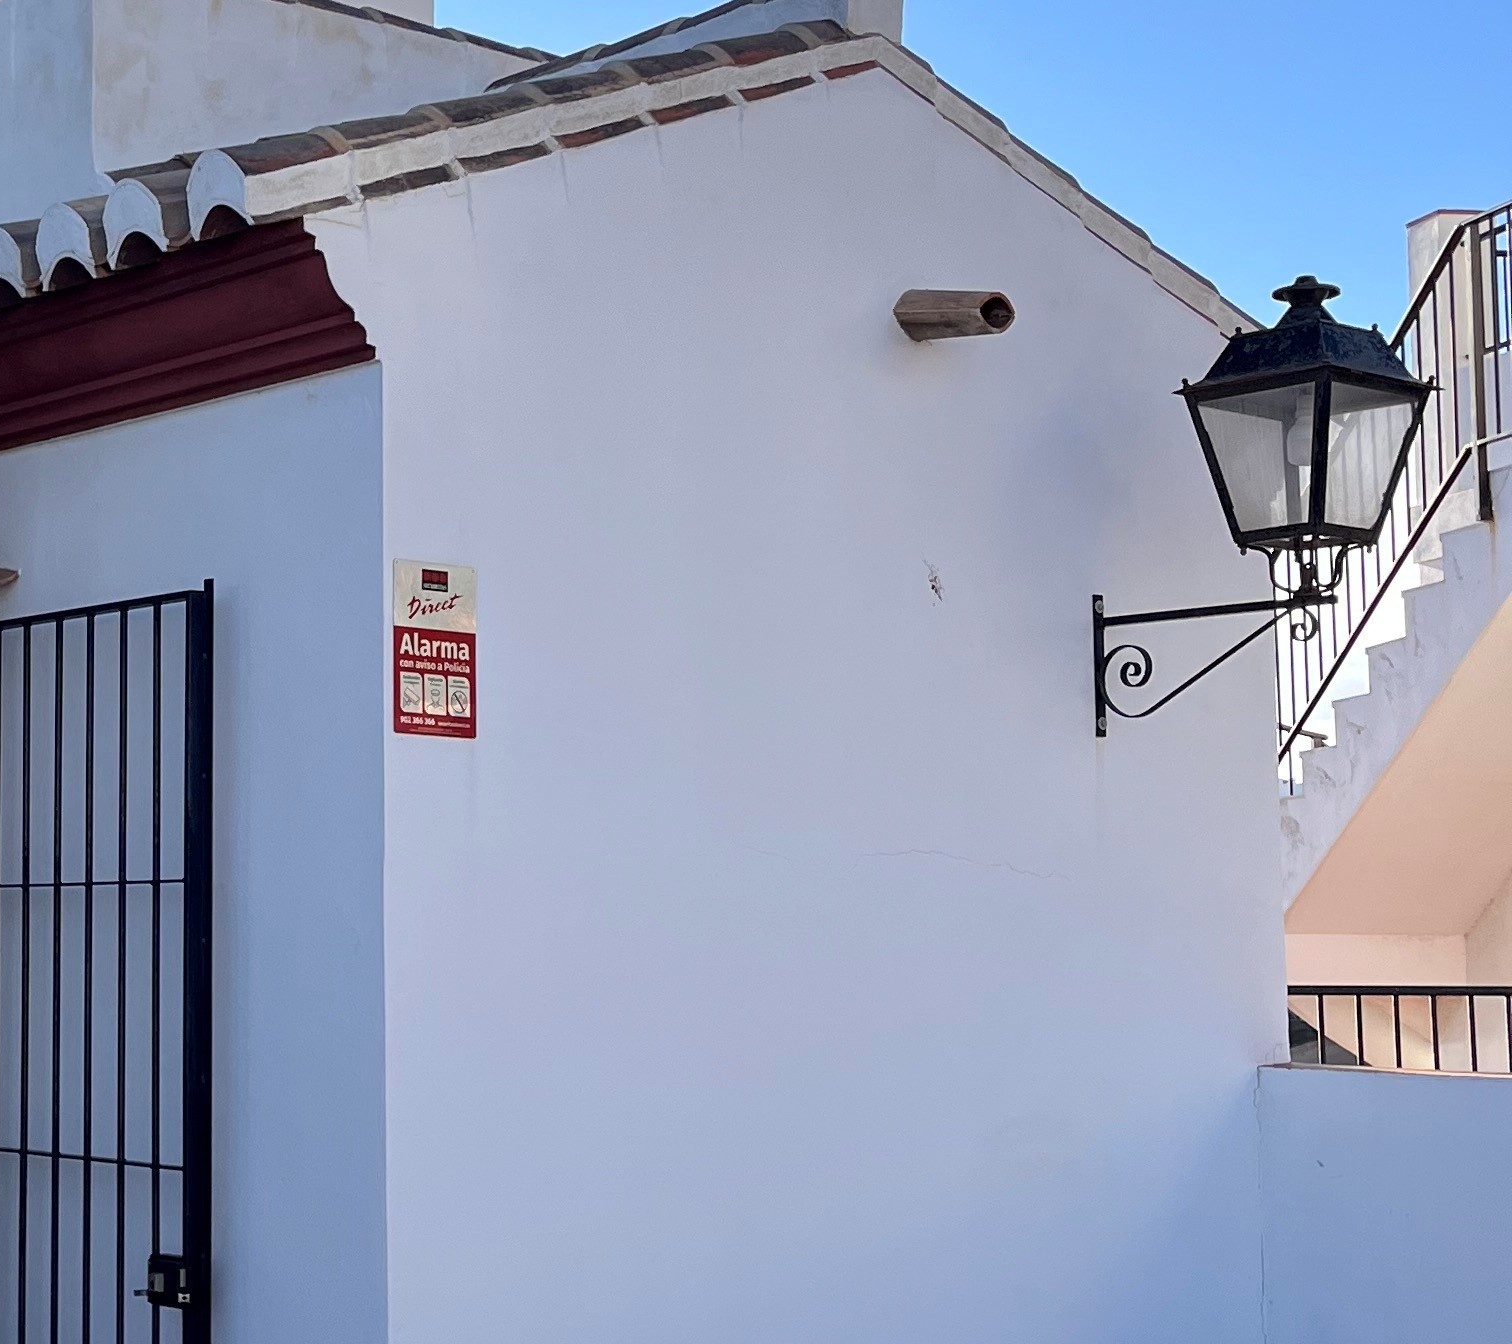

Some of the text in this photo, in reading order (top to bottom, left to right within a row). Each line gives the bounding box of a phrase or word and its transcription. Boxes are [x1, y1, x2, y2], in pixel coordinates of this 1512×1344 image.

[407, 593, 463, 619] Direct
[399, 632, 470, 661] Alarma
[399, 659, 414, 668] con
[415, 658, 436, 671] aviso
[437, 662, 443, 671] a
